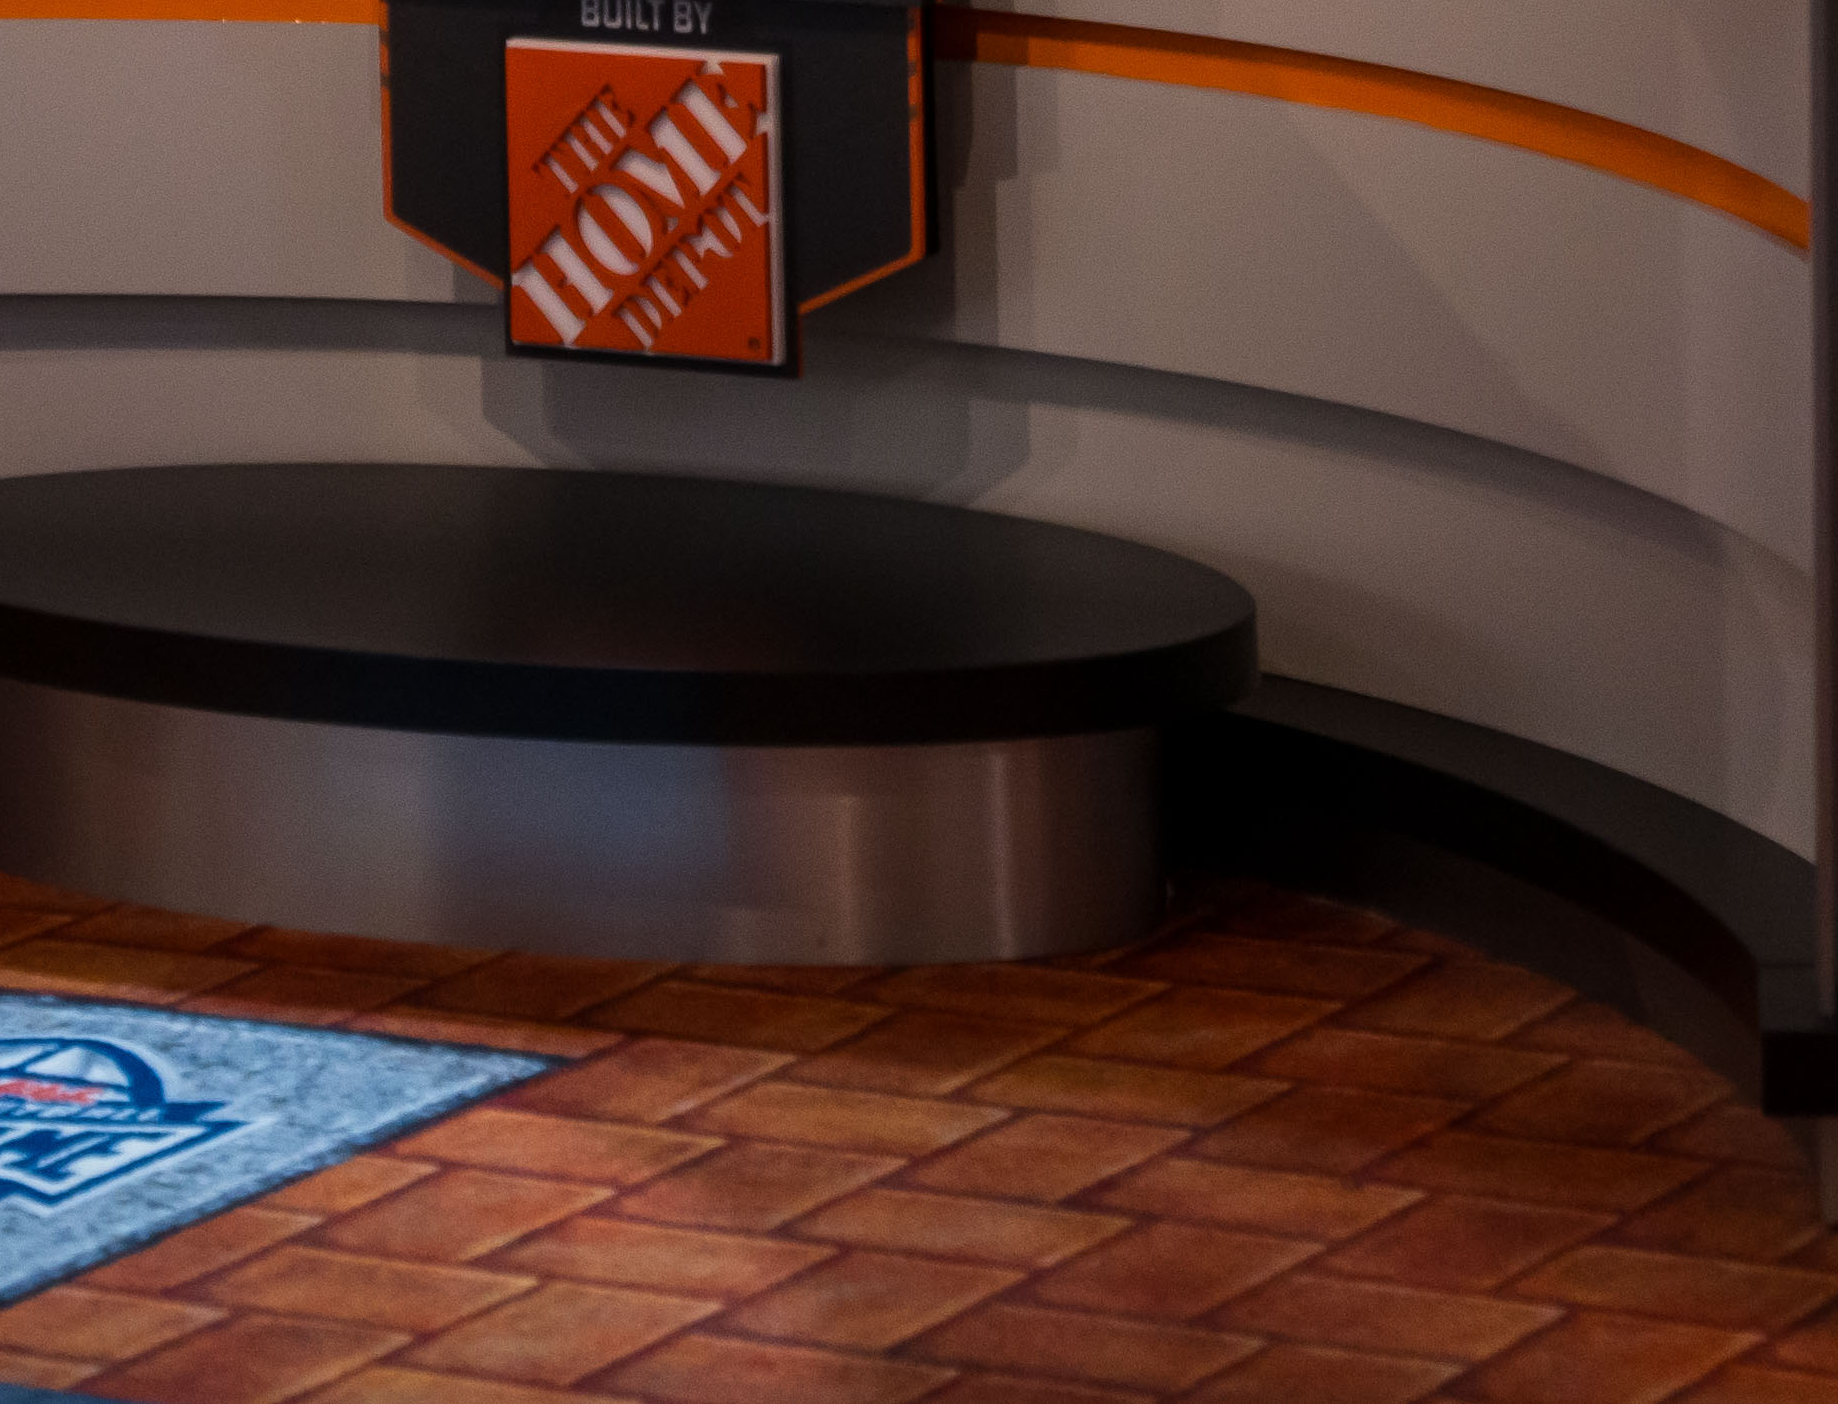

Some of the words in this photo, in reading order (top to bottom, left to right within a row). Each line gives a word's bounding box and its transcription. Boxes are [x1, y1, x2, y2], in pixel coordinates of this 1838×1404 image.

[513, 59, 769, 349] HOME
[531, 83, 636, 193] THE
[612, 172, 769, 353] DEPOT
